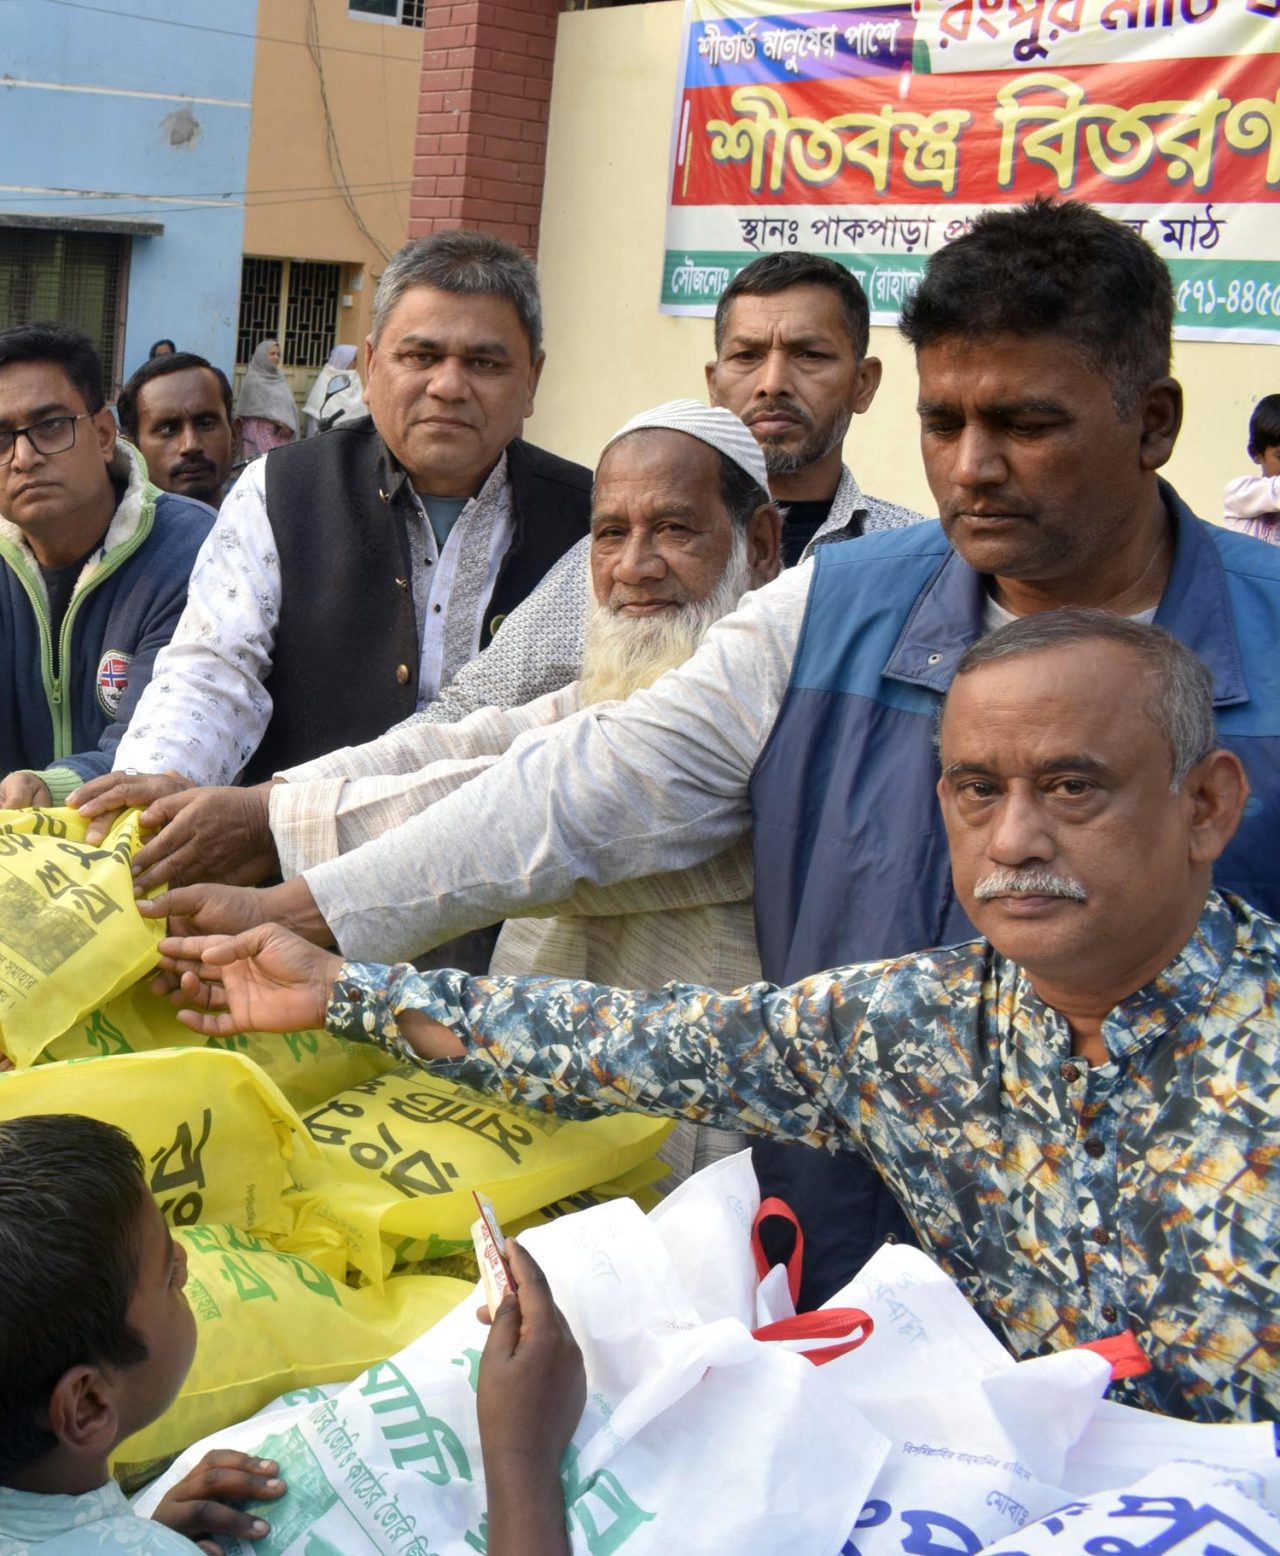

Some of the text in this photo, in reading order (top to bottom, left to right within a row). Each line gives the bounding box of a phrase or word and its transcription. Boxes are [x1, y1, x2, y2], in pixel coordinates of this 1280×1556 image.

[697, 19, 901, 73] শীতার্ত মানুষের পাশে
[706, 86, 972, 197] শীতবস্ত্র
[810, 215, 936, 253] পাকপাড়া
[1158, 203, 1228, 252] মাঠ
[5, 961, 38, 990] সমাহার
[345, 1457, 389, 1509] কাঠের
[374, 1493, 416, 1543] তৈরি
